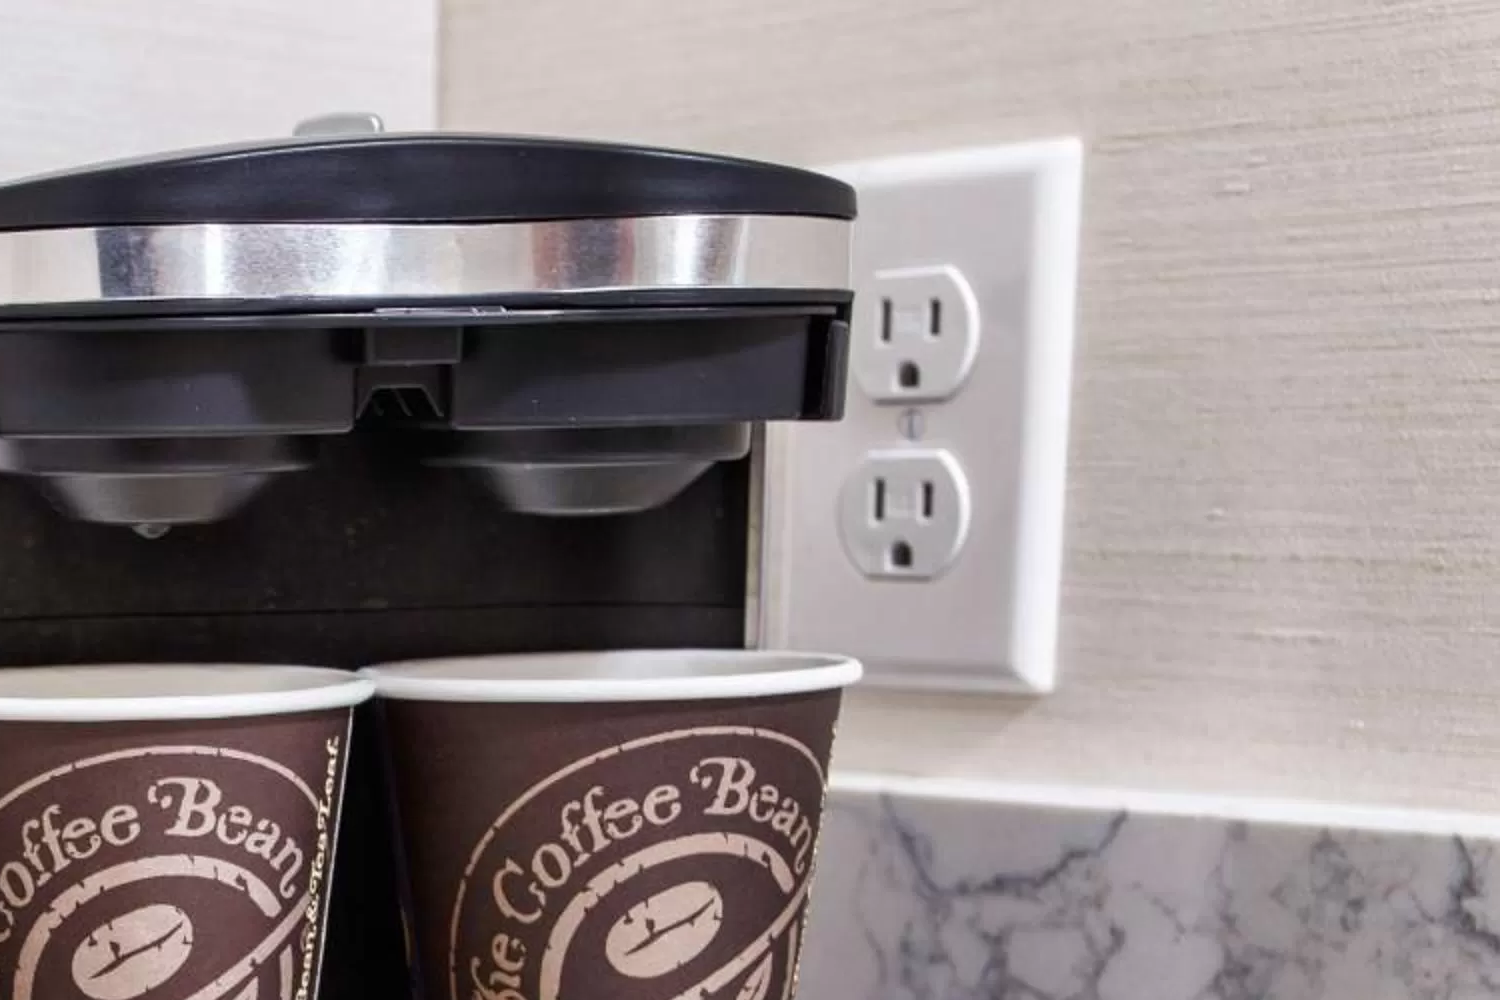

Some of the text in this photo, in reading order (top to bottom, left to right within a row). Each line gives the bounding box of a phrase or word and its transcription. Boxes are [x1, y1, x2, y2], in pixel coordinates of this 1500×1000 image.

[147, 776, 304, 899] Bean
[492, 783, 682, 925] Coffee
[689, 755, 812, 874] Bean
